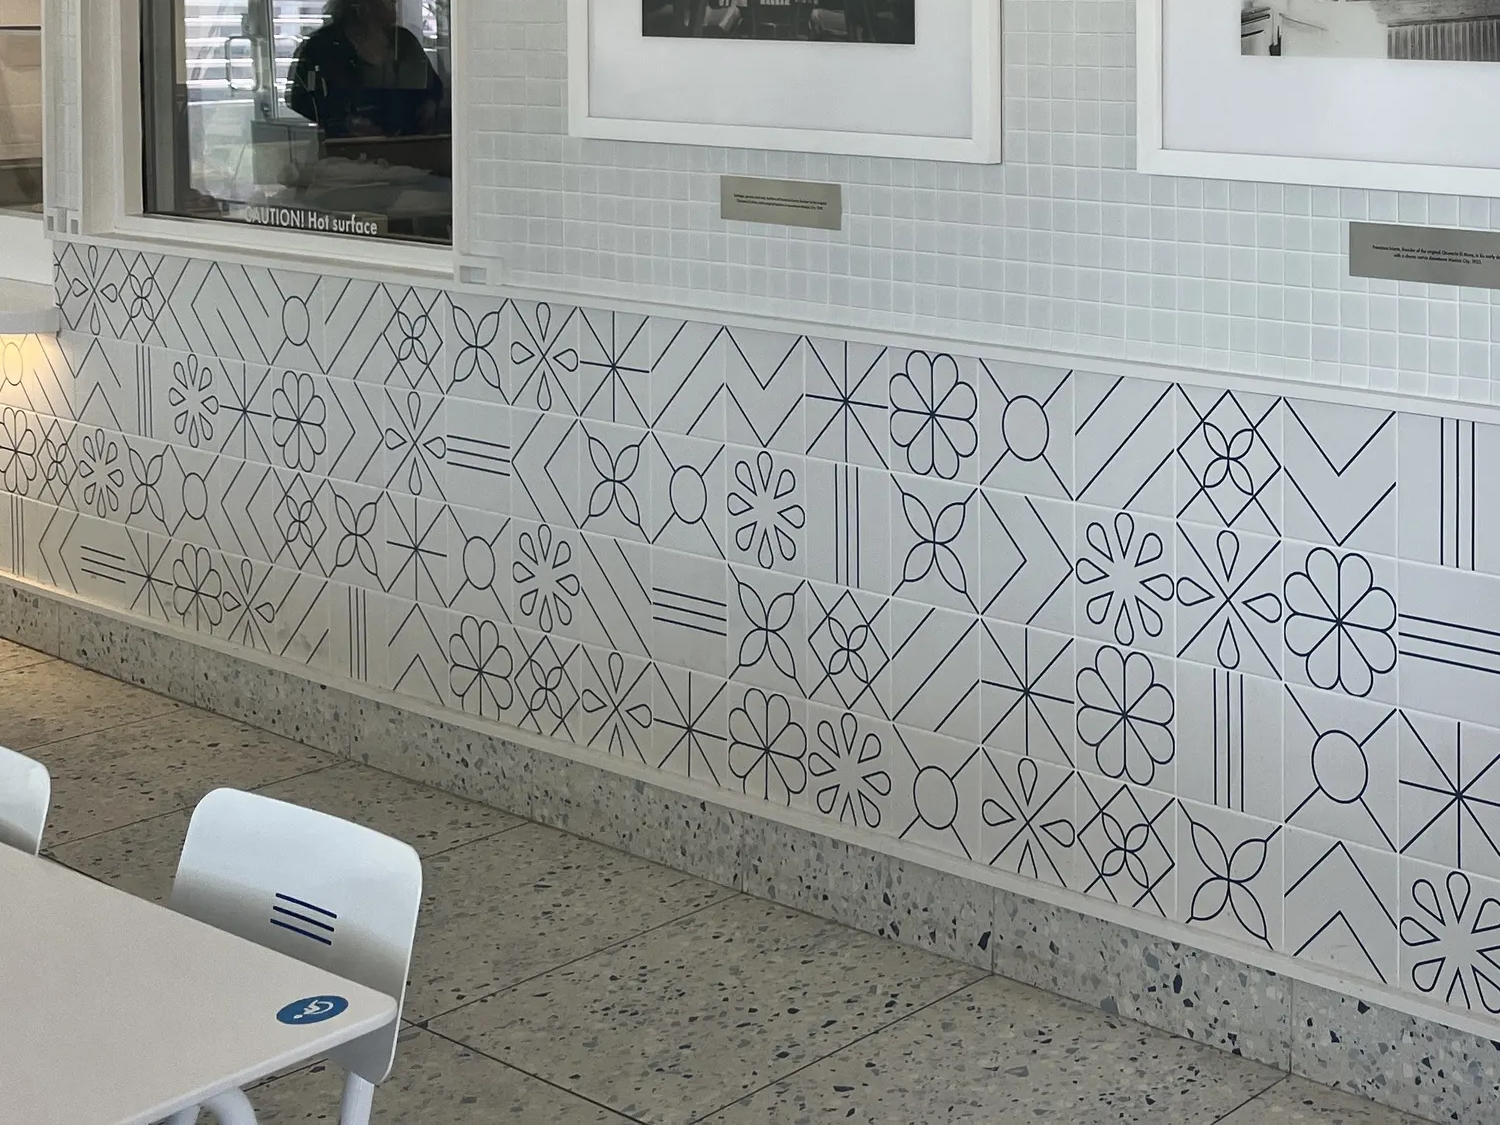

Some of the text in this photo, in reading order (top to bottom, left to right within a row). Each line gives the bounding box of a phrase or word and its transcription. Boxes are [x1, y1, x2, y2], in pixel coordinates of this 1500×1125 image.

[245, 206, 378, 235] CAUTION! Hot surface
